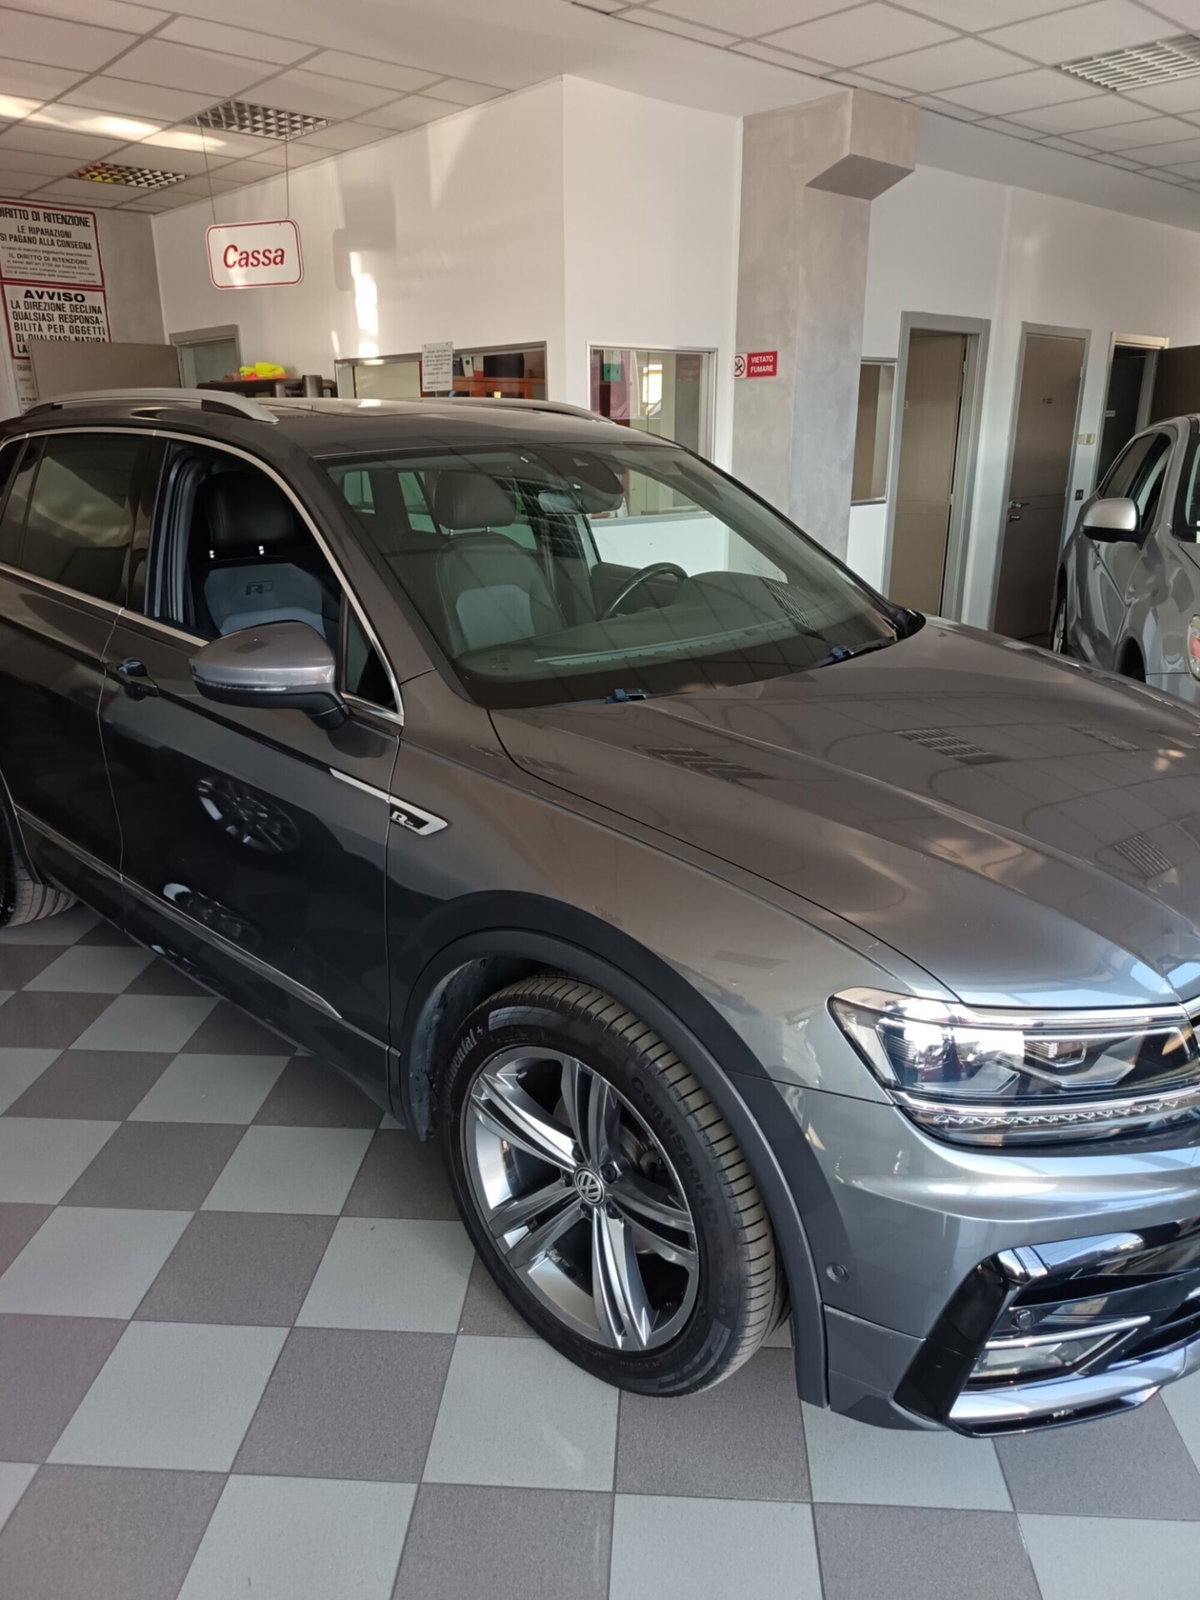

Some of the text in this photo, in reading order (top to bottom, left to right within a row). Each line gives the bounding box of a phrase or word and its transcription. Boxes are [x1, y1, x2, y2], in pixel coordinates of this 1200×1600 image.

[31, 210, 40, 221] DI
[43, 212, 91, 227] RITENZIONE
[17, 225, 72, 238] LE RIPARAZIONI
[9, 234, 37, 245] PAGANO
[39, 237, 55, 247] ALLA
[56, 239, 92, 250] CONSEGNA
[223, 244, 285, 269] Cassa
[24, 289, 86, 303] AVVISO
[10, 300, 102, 315] LA DIREZIONE DECLINA
[12, 311, 104, 325] QUALSIASI RESPONSA-
[47, 324, 66, 334] PER
[69, 325, 106, 336] OGGETTI
[16, 333, 25, 342] DI
[750, 355, 774, 363] VIETATO
[750, 365, 774, 373] FUMARE
